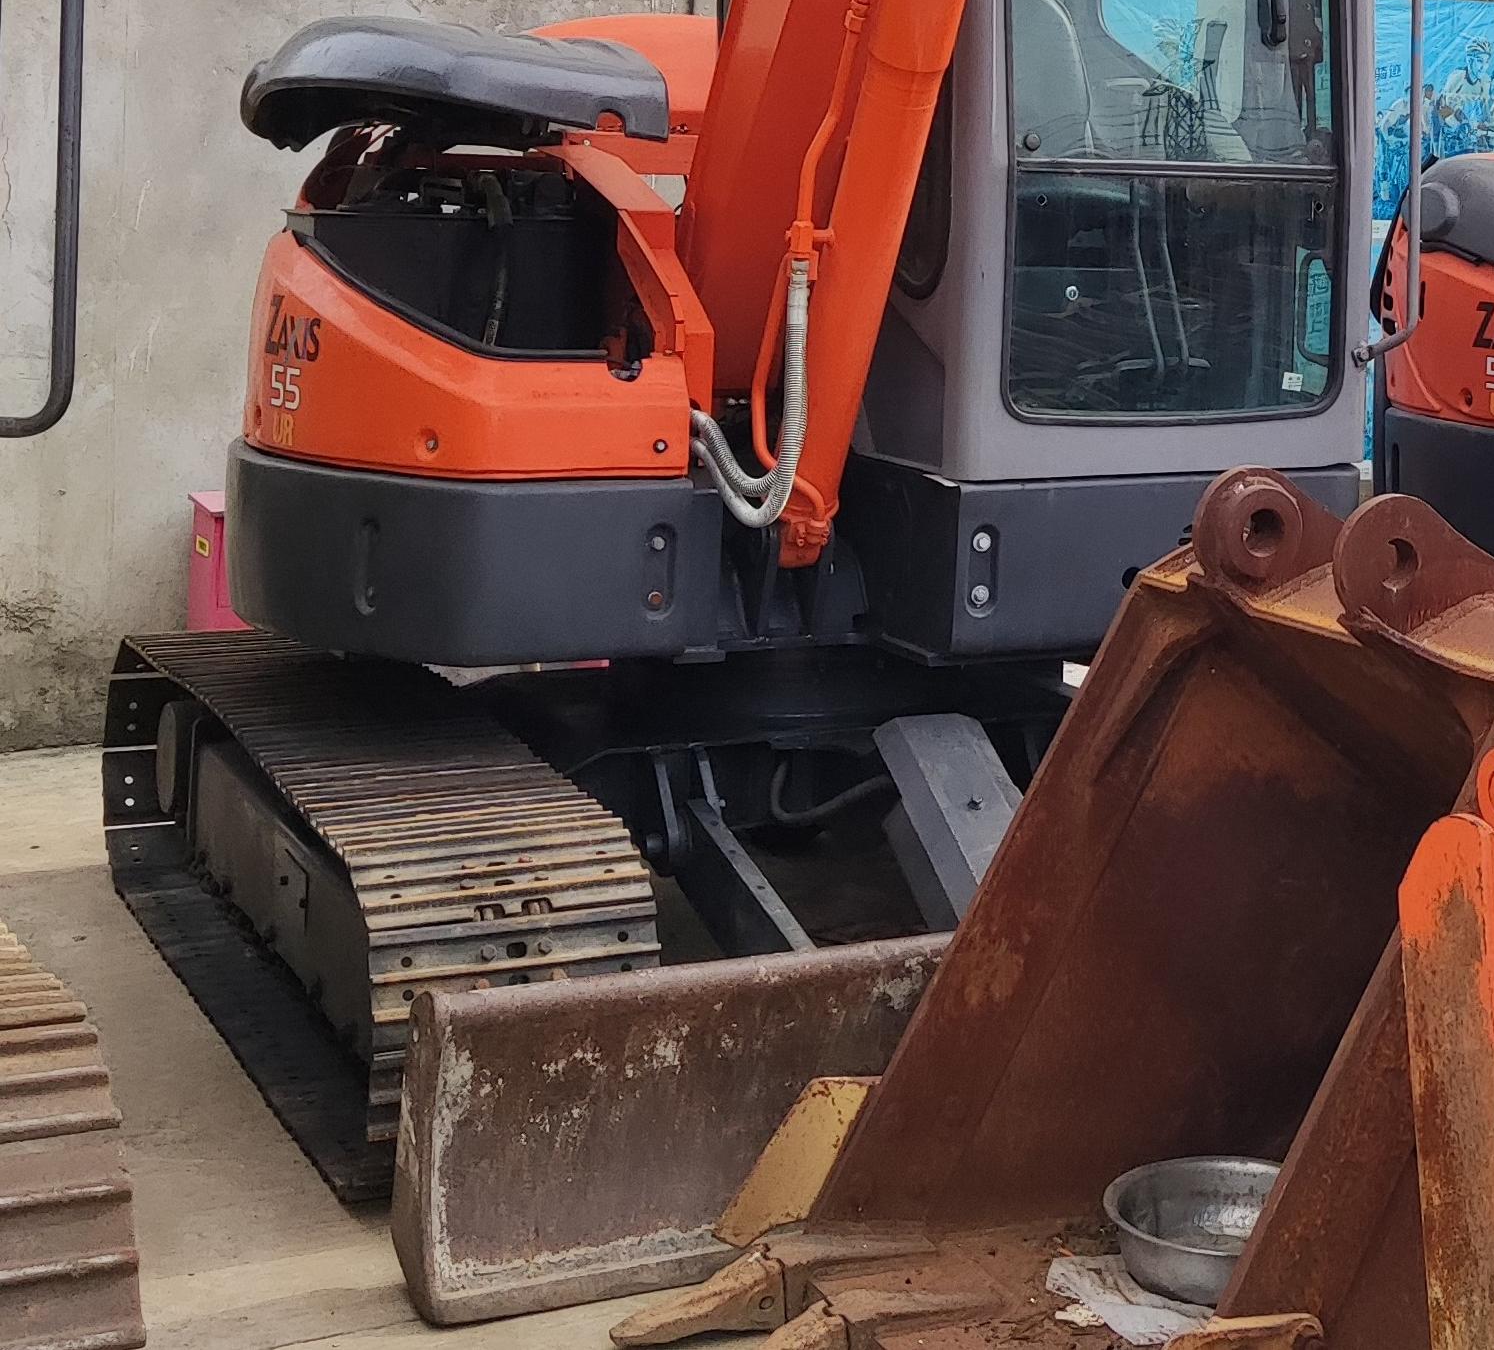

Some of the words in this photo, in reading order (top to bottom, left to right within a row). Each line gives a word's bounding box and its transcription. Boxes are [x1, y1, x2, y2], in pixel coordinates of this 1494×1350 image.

[264, 295, 321, 363] ZAXIS
[270, 363, 301, 410] 55
[272, 412, 295, 446] UR
